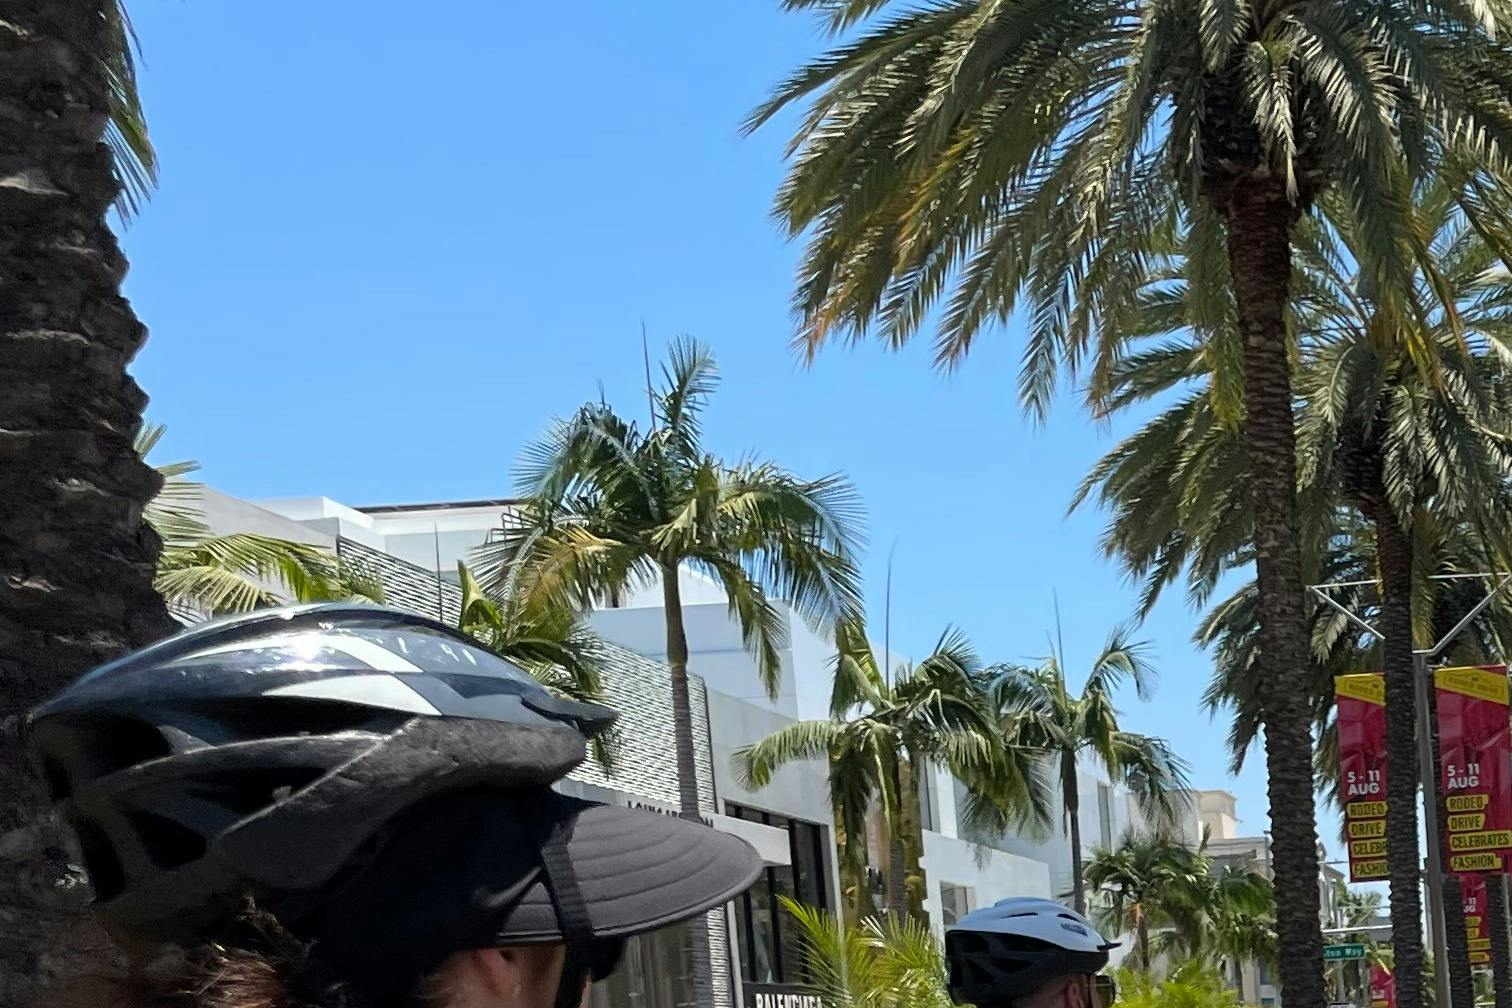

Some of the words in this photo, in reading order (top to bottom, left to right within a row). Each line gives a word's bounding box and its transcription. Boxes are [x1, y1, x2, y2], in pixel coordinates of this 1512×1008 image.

[1347, 772, 1356, 783] 5
[1368, 770, 1380, 782] 11
[1447, 765, 1456, 776] 5
[1468, 763, 1480, 775] 11
[1347, 782, 1380, 796] AUG
[1447, 775, 1480, 789] AUG
[1350, 803, 1385, 817] RODEO
[1449, 797, 1484, 809] RODEO
[1352, 822, 1382, 836] DRIVE
[1450, 815, 1481, 830] DRIVE
[1452, 833, 1510, 850] CELEBRATES
[1453, 855, 1496, 870] FASHION
